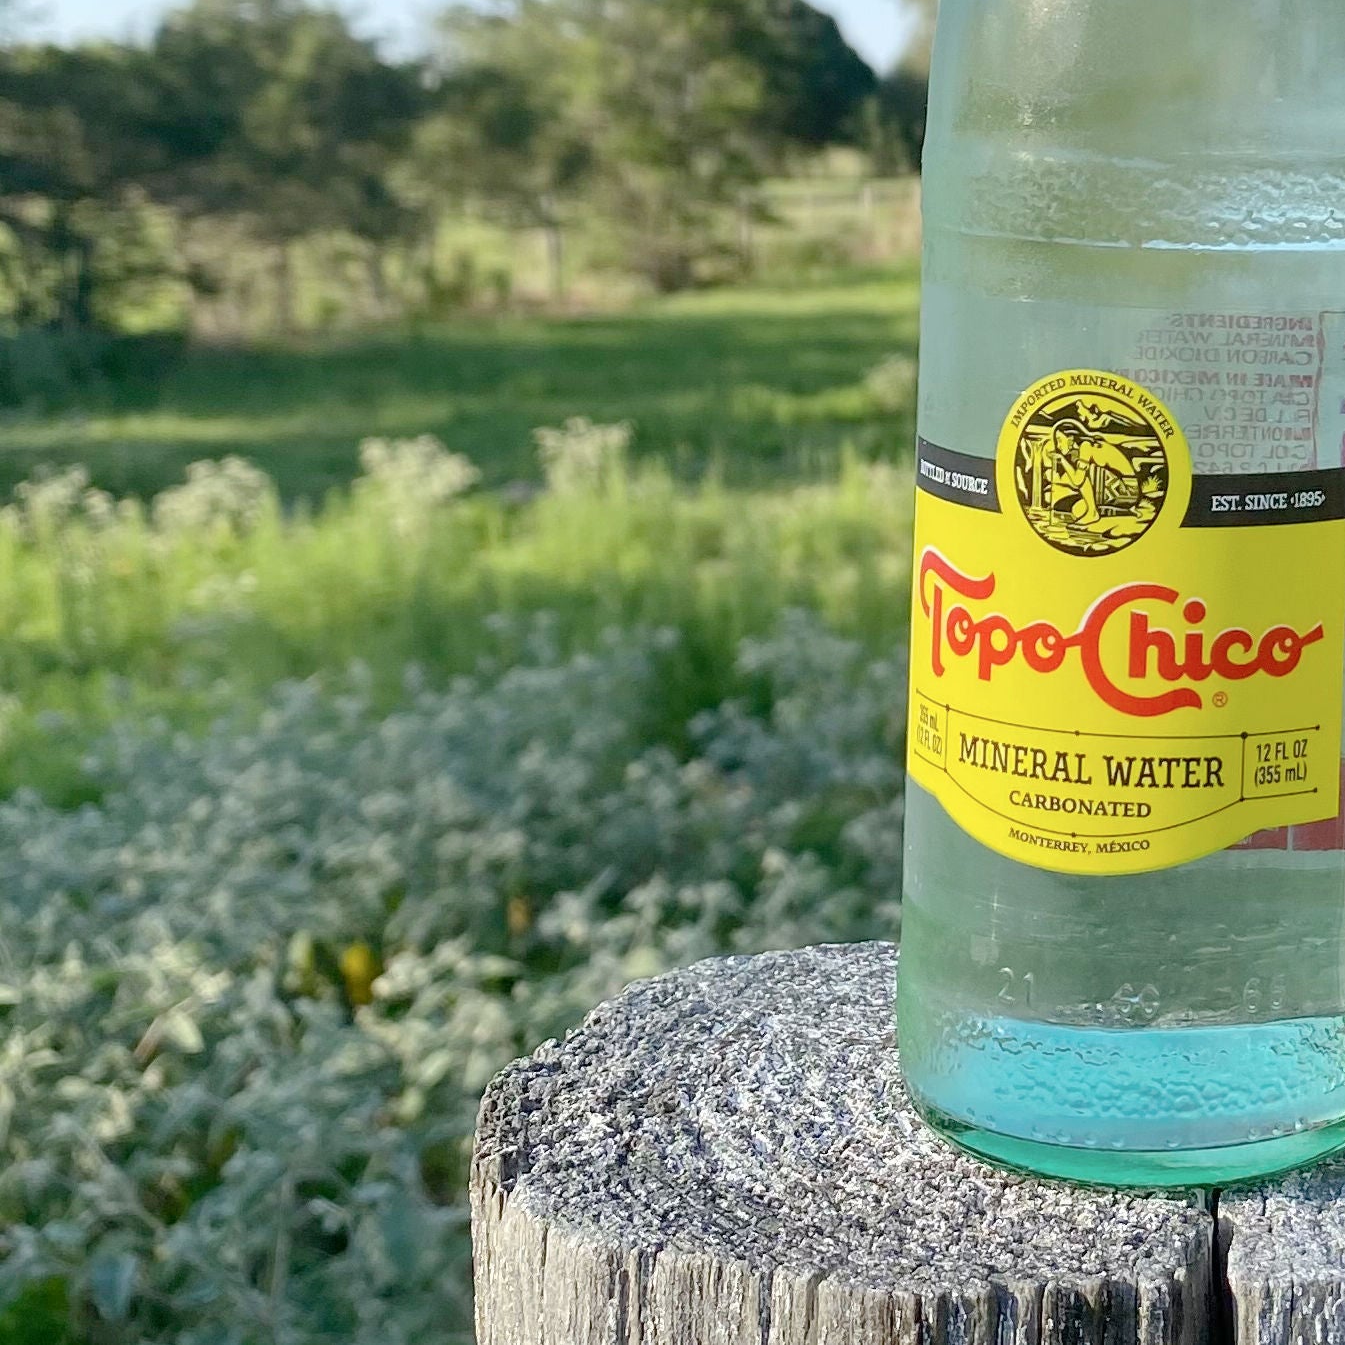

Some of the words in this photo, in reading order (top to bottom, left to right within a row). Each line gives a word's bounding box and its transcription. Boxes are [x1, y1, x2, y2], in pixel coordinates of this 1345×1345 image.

[1010, 377, 1067, 429] IMPORTED
[1069, 374, 1134, 399] MINERAL
[1137, 394, 1176, 440] WATER
[951, 472, 989, 495] SOURCE
[1211, 495, 1242, 512] EST.
[1244, 493, 1288, 511] SINCE
[919, 544, 1083, 682] Topo
[1079, 581, 1324, 718] Chico
[924, 728, 931, 751] FL
[1255, 743, 1272, 763] 12
[1274, 741, 1290, 760] FL
[1293, 738, 1308, 758] OZ
[958, 731, 1093, 786] MINERAL
[1102, 755, 1225, 789] WATER
[1254, 764, 1281, 788] (355
[1284, 760, 1308, 783] mL)
[1008, 789, 1152, 818] CARBONATED
[1008, 827, 1092, 855] MONTERREY,
[1095, 838, 1151, 854] MÉXICO
